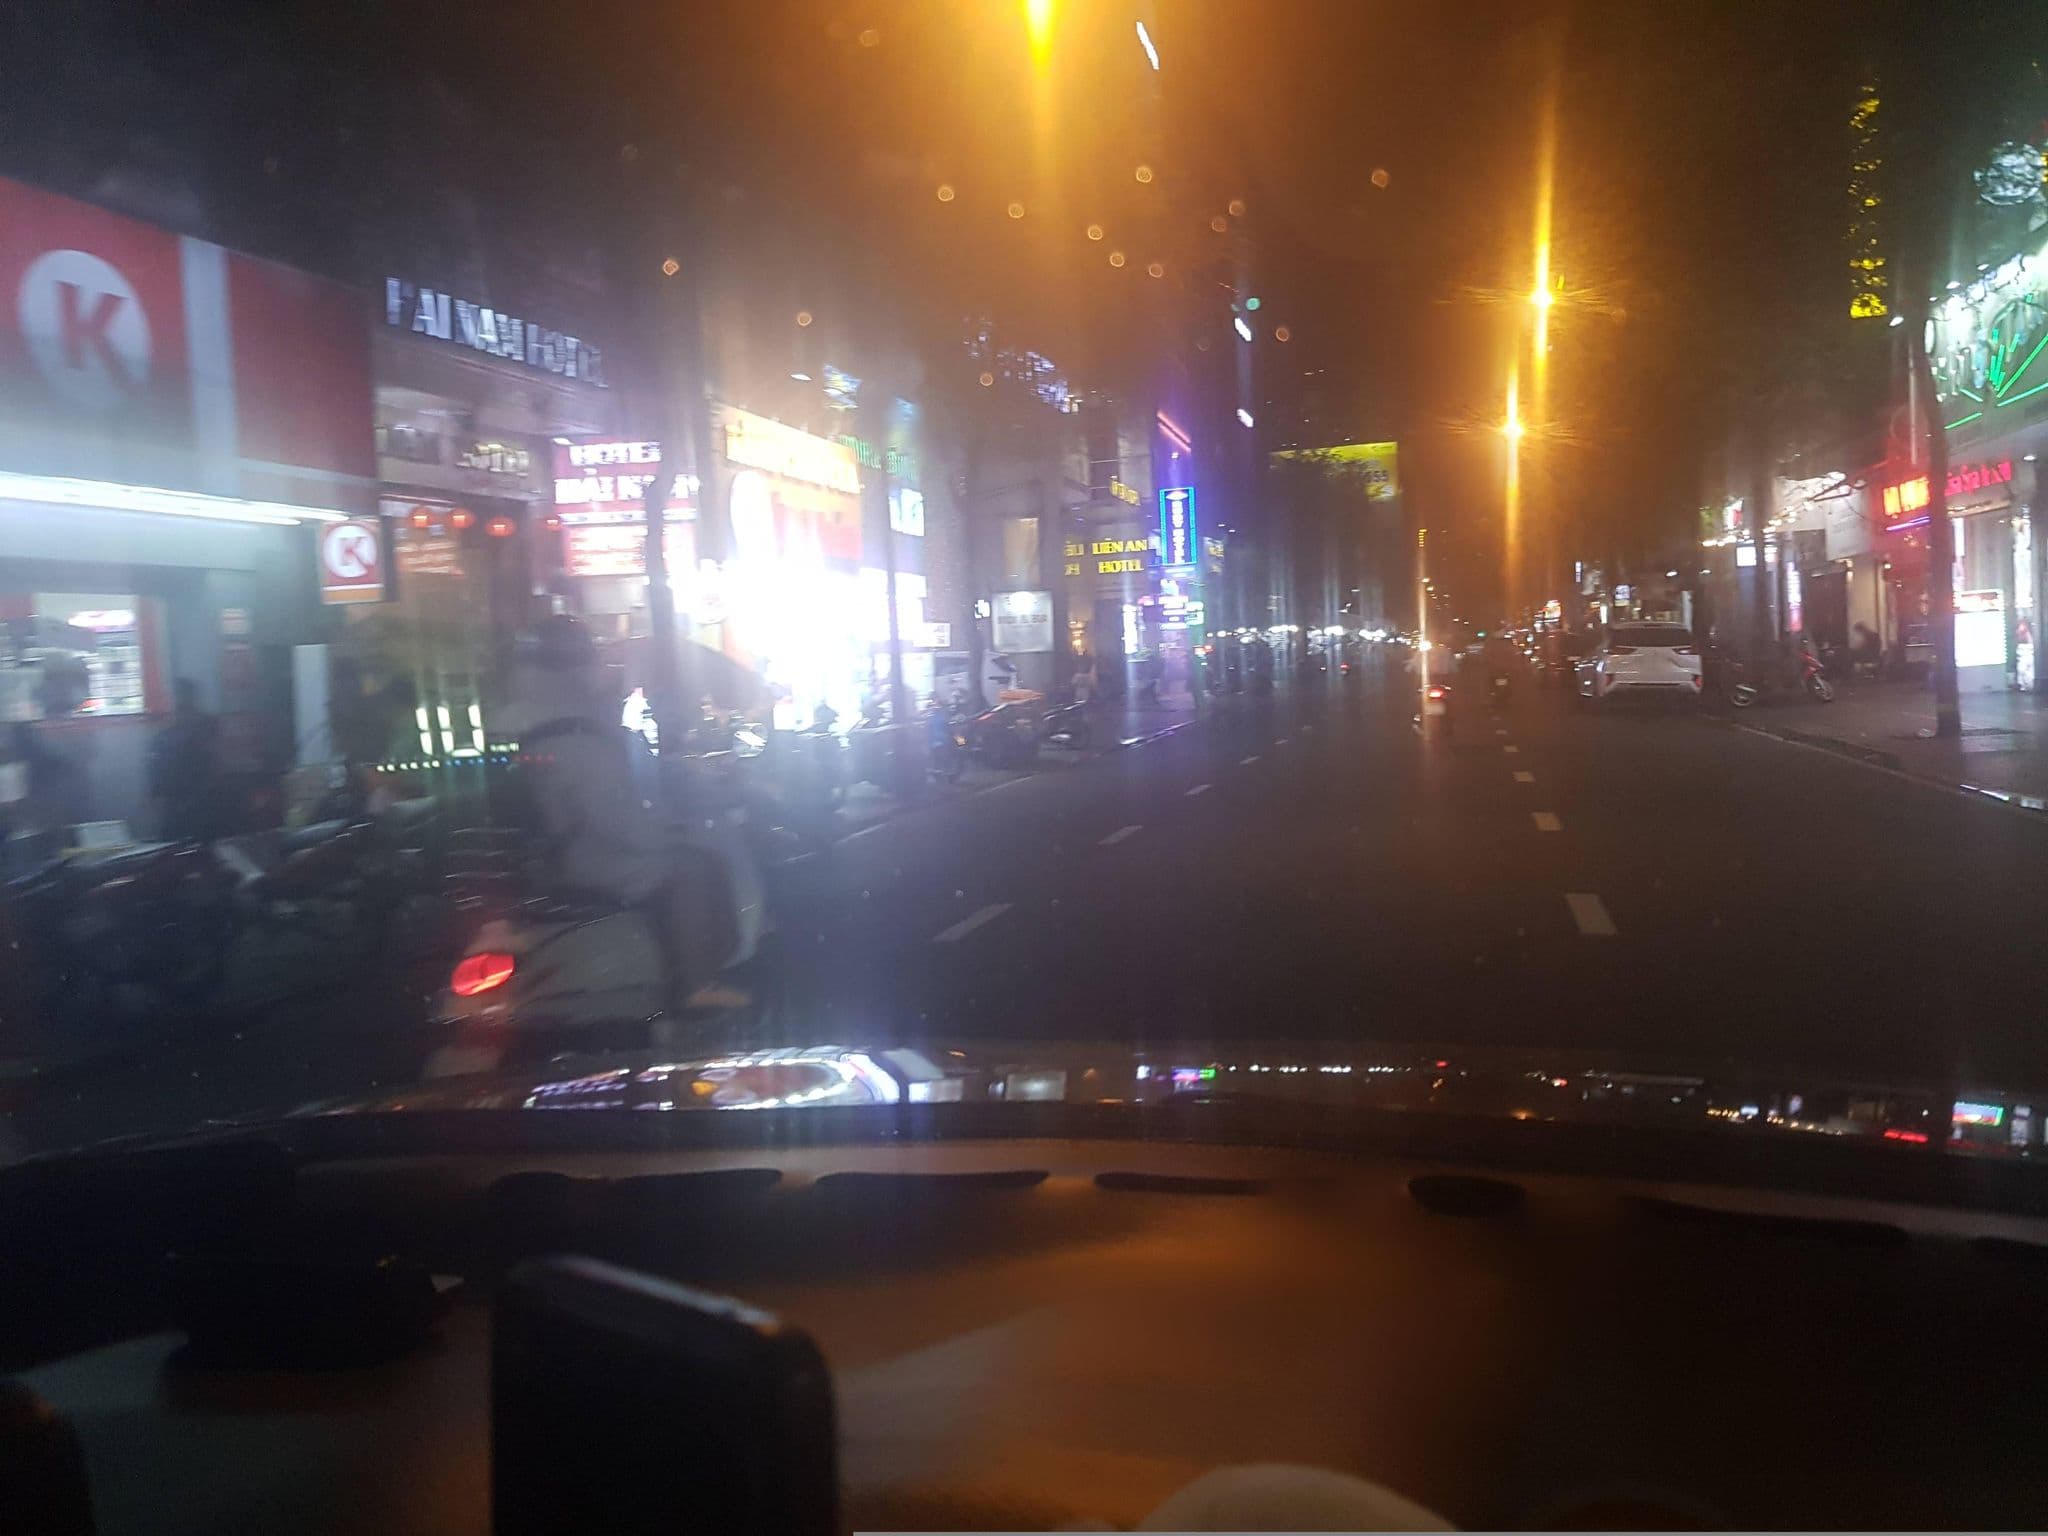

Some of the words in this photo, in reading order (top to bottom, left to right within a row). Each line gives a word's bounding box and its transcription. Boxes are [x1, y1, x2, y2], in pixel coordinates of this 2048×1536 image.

[56, 279, 150, 390] K
[1125, 539, 1148, 553] AN
[1098, 559, 1145, 574] HOTEL
